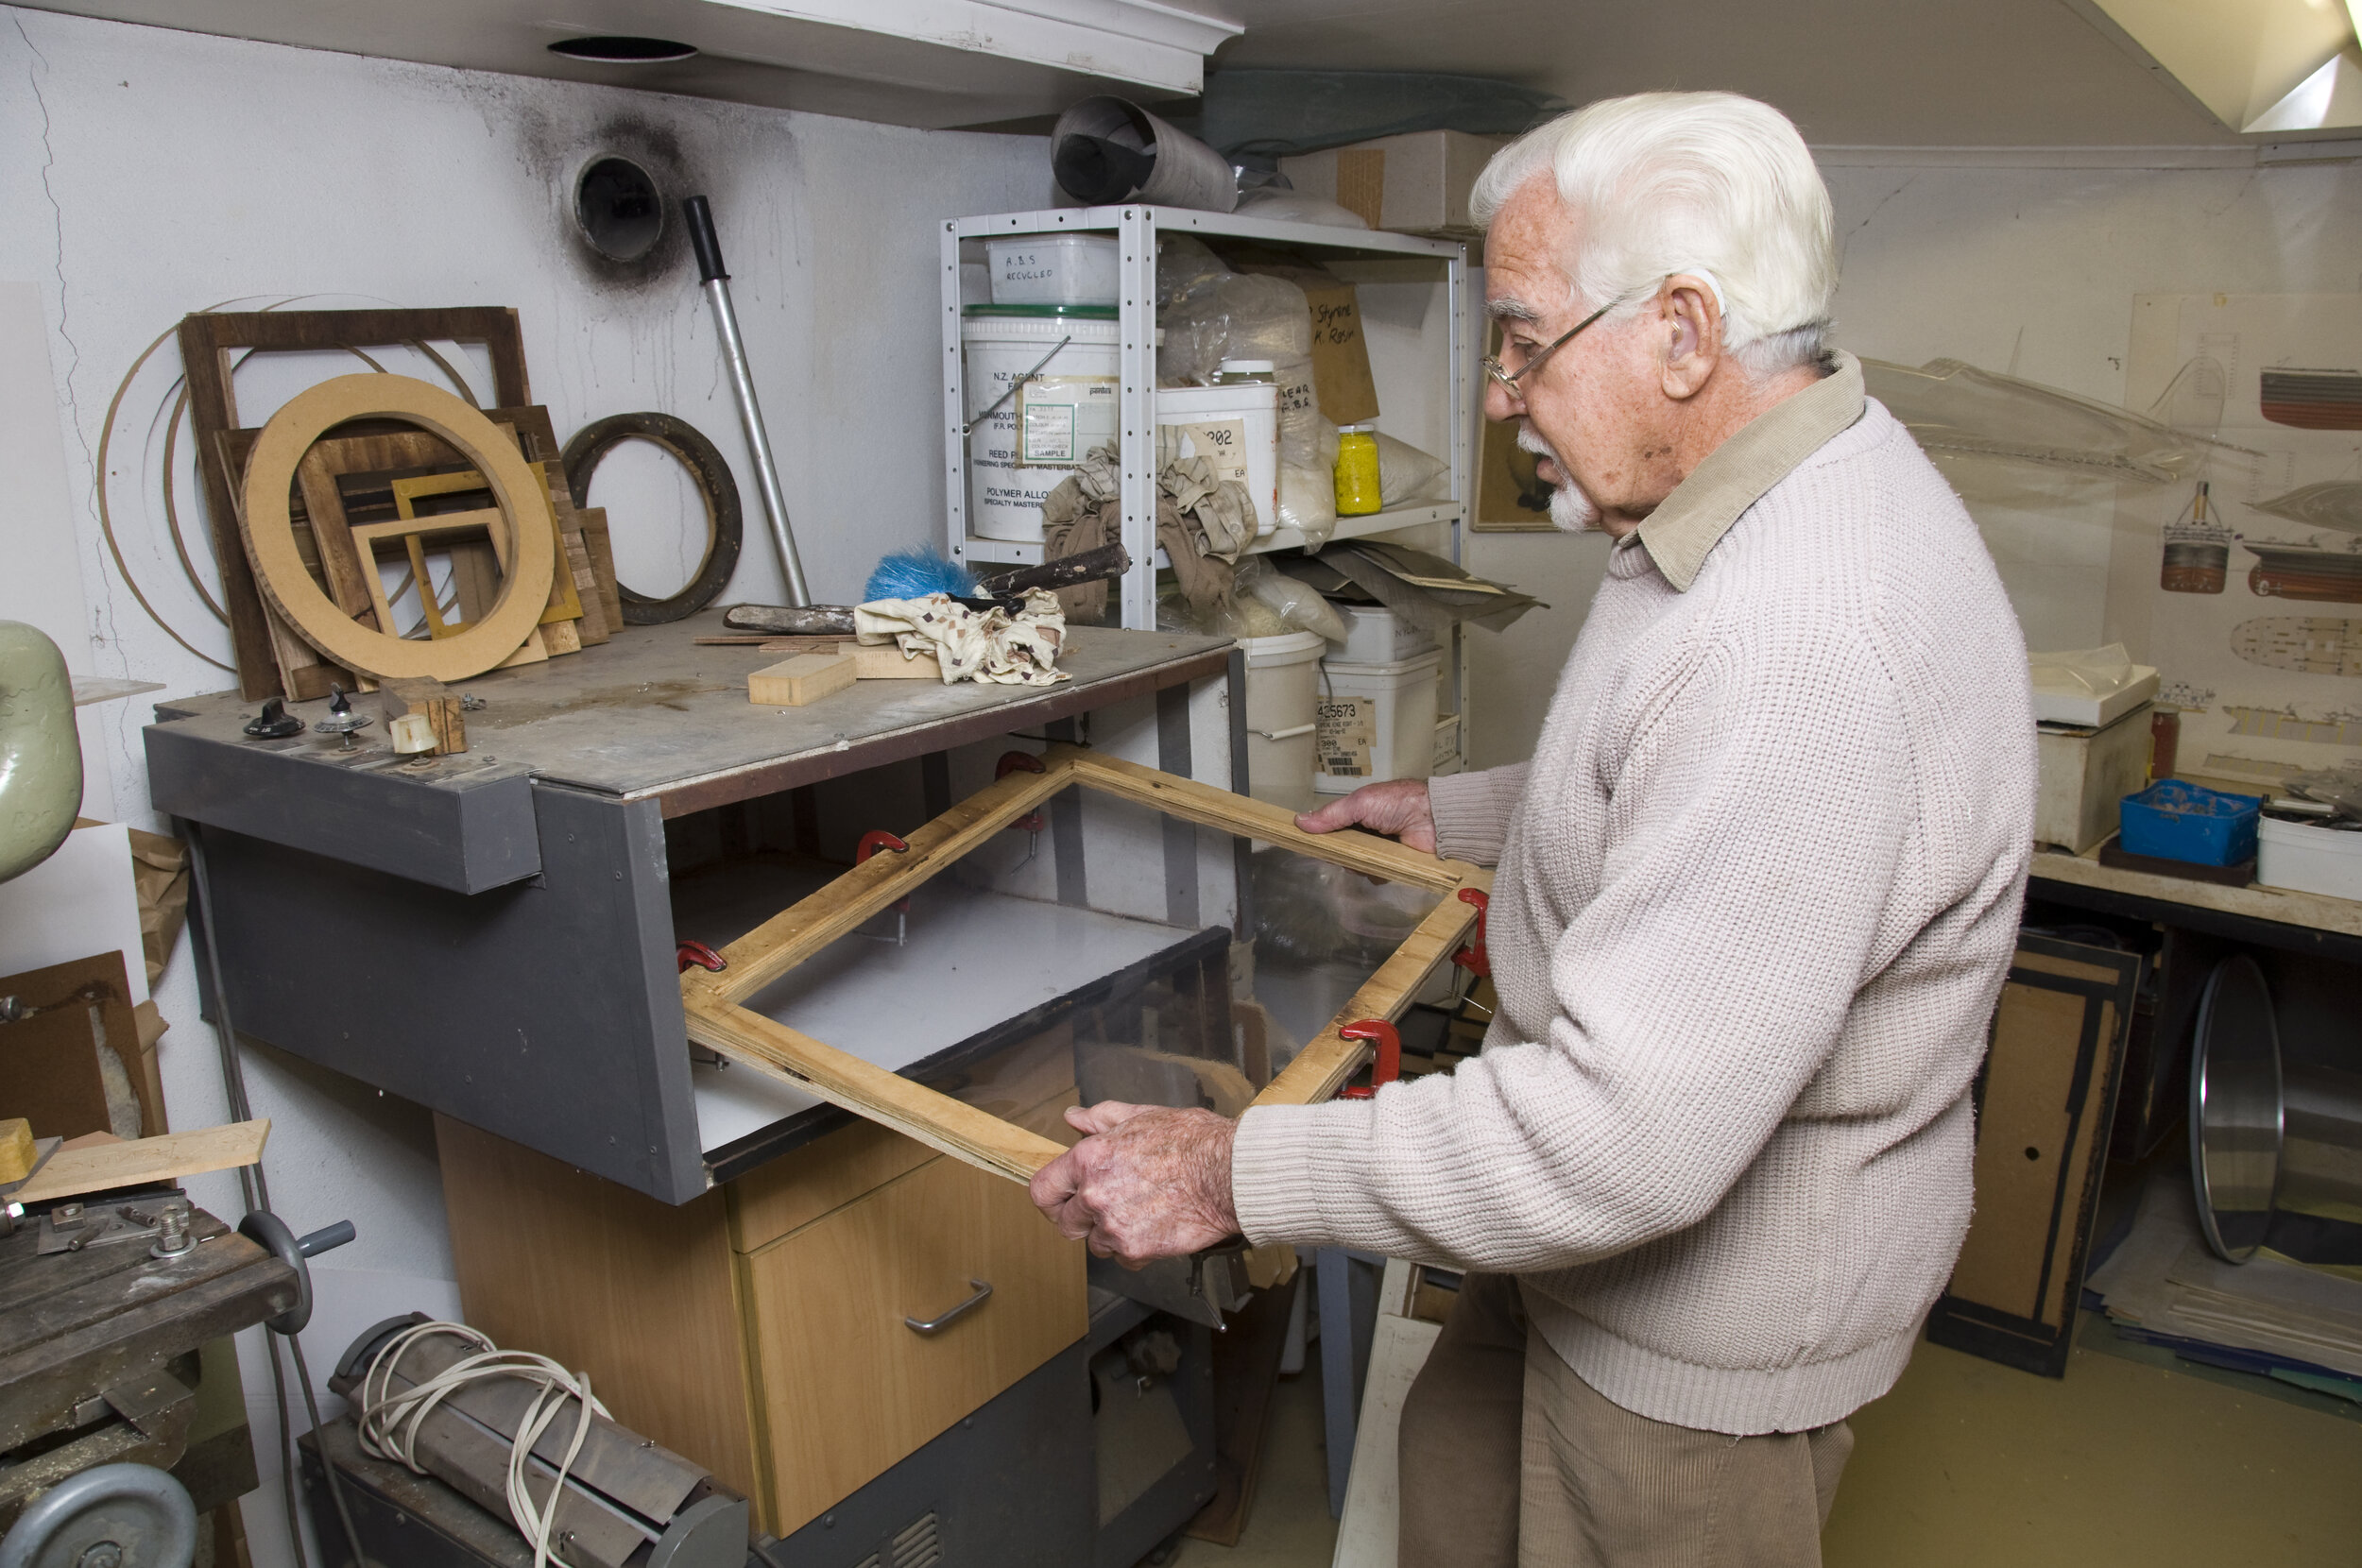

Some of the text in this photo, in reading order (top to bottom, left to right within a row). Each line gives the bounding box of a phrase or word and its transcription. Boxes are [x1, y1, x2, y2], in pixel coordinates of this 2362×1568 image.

[988, 450, 1008, 459] REED
[1235, 469, 1245, 478] EA
[986, 487, 1022, 498] POLYMER
[984, 499, 1011, 507] SPECIALTY
[1358, 738, 1367, 746] EA
